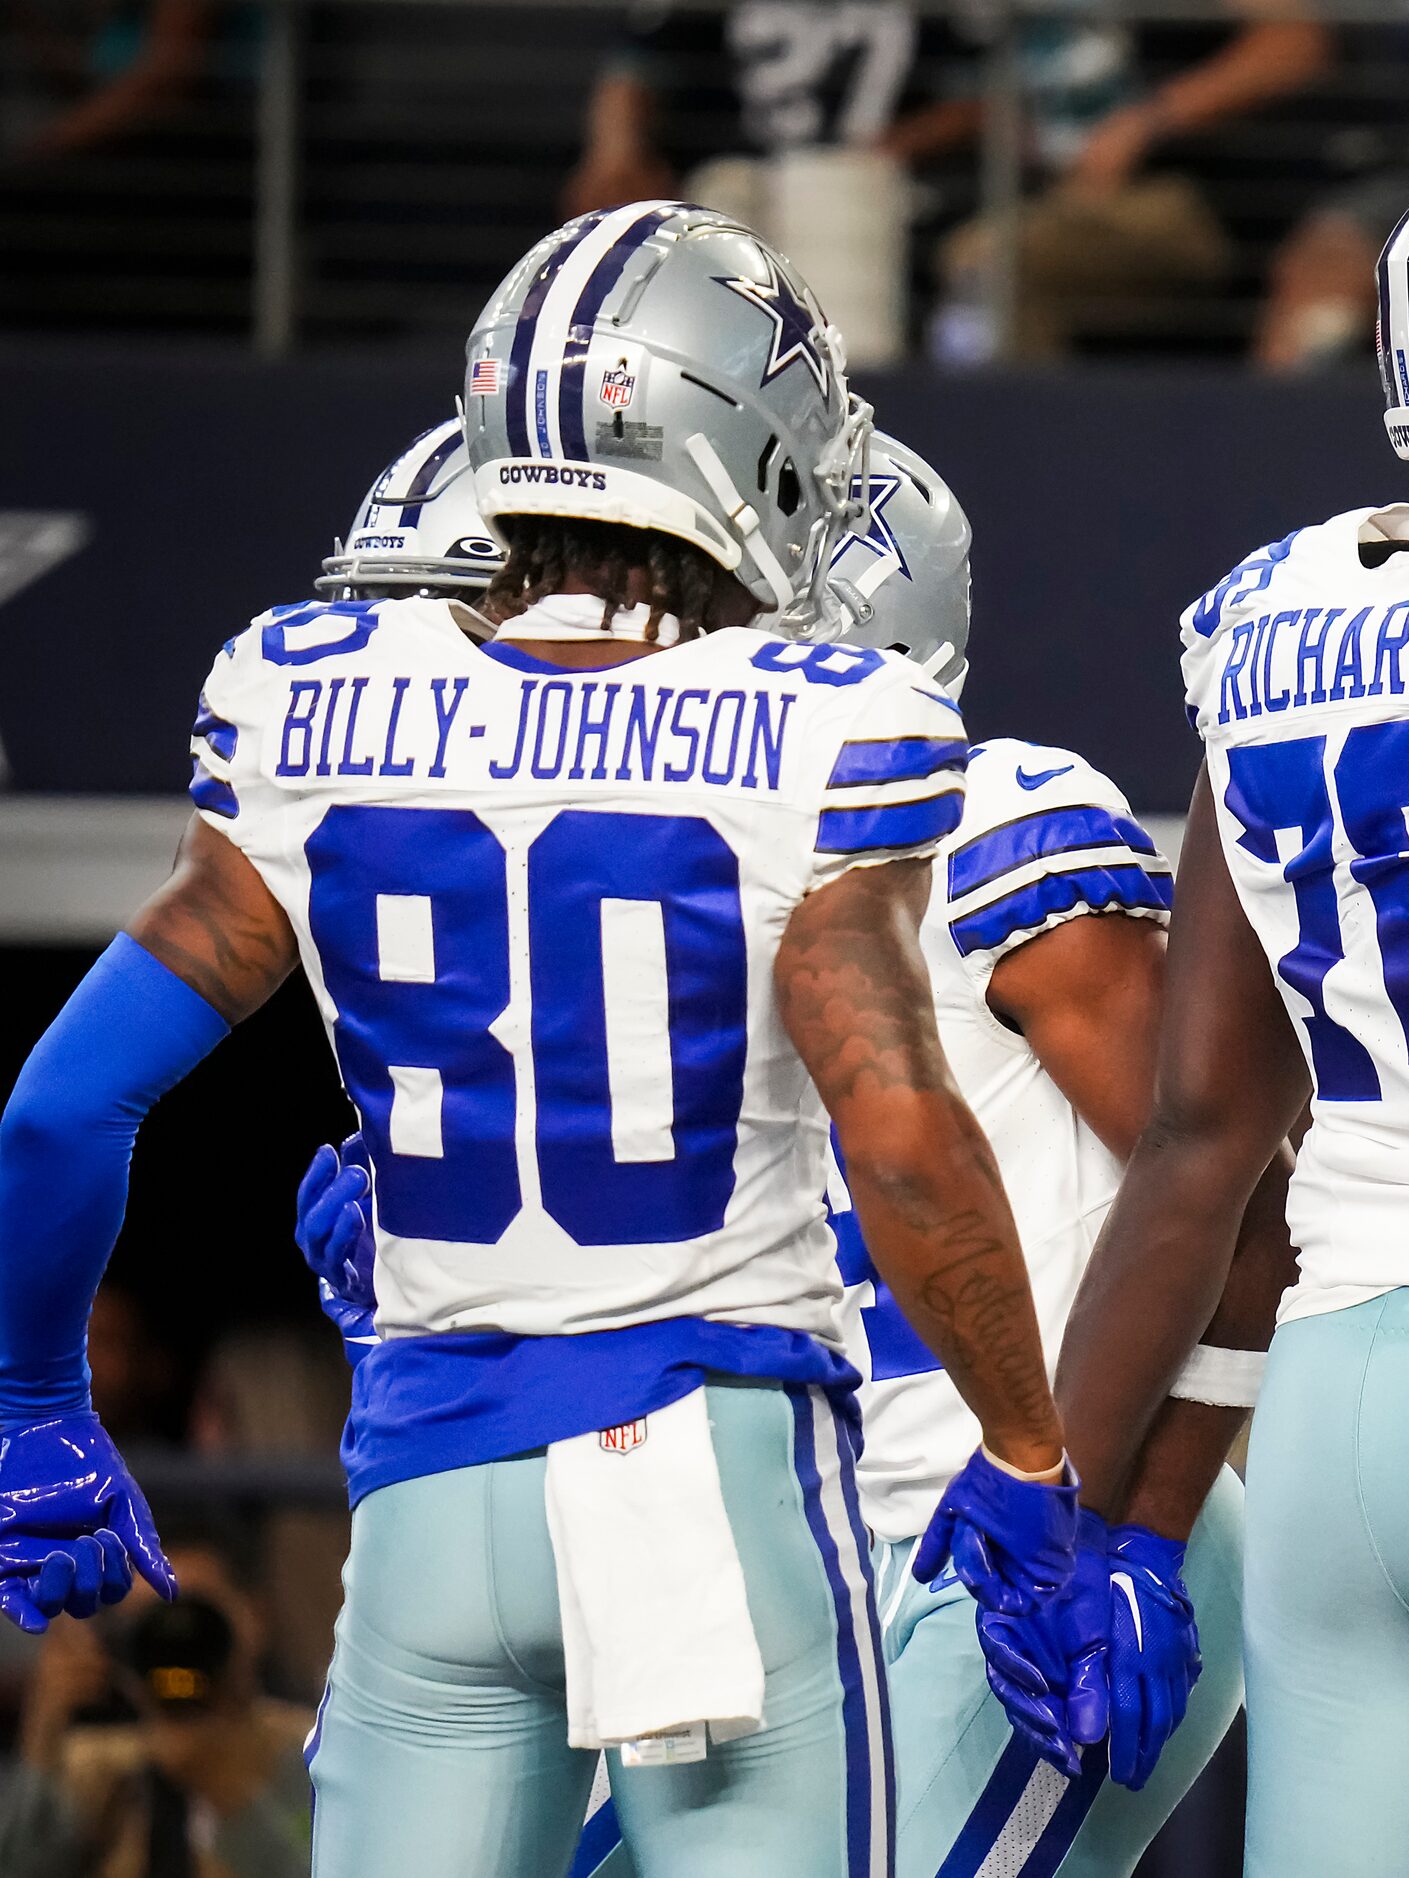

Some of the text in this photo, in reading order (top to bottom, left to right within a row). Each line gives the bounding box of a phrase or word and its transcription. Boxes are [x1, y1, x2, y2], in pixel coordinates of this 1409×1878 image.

[731, 2, 912, 143] 27
[604, 384, 629, 405] NFL
[500, 465, 606, 490] COWBOYS
[275, 677, 796, 790] BILLY-JOHNSON
[304, 804, 747, 1246] 80
[605, 1421, 643, 1450] NFL
